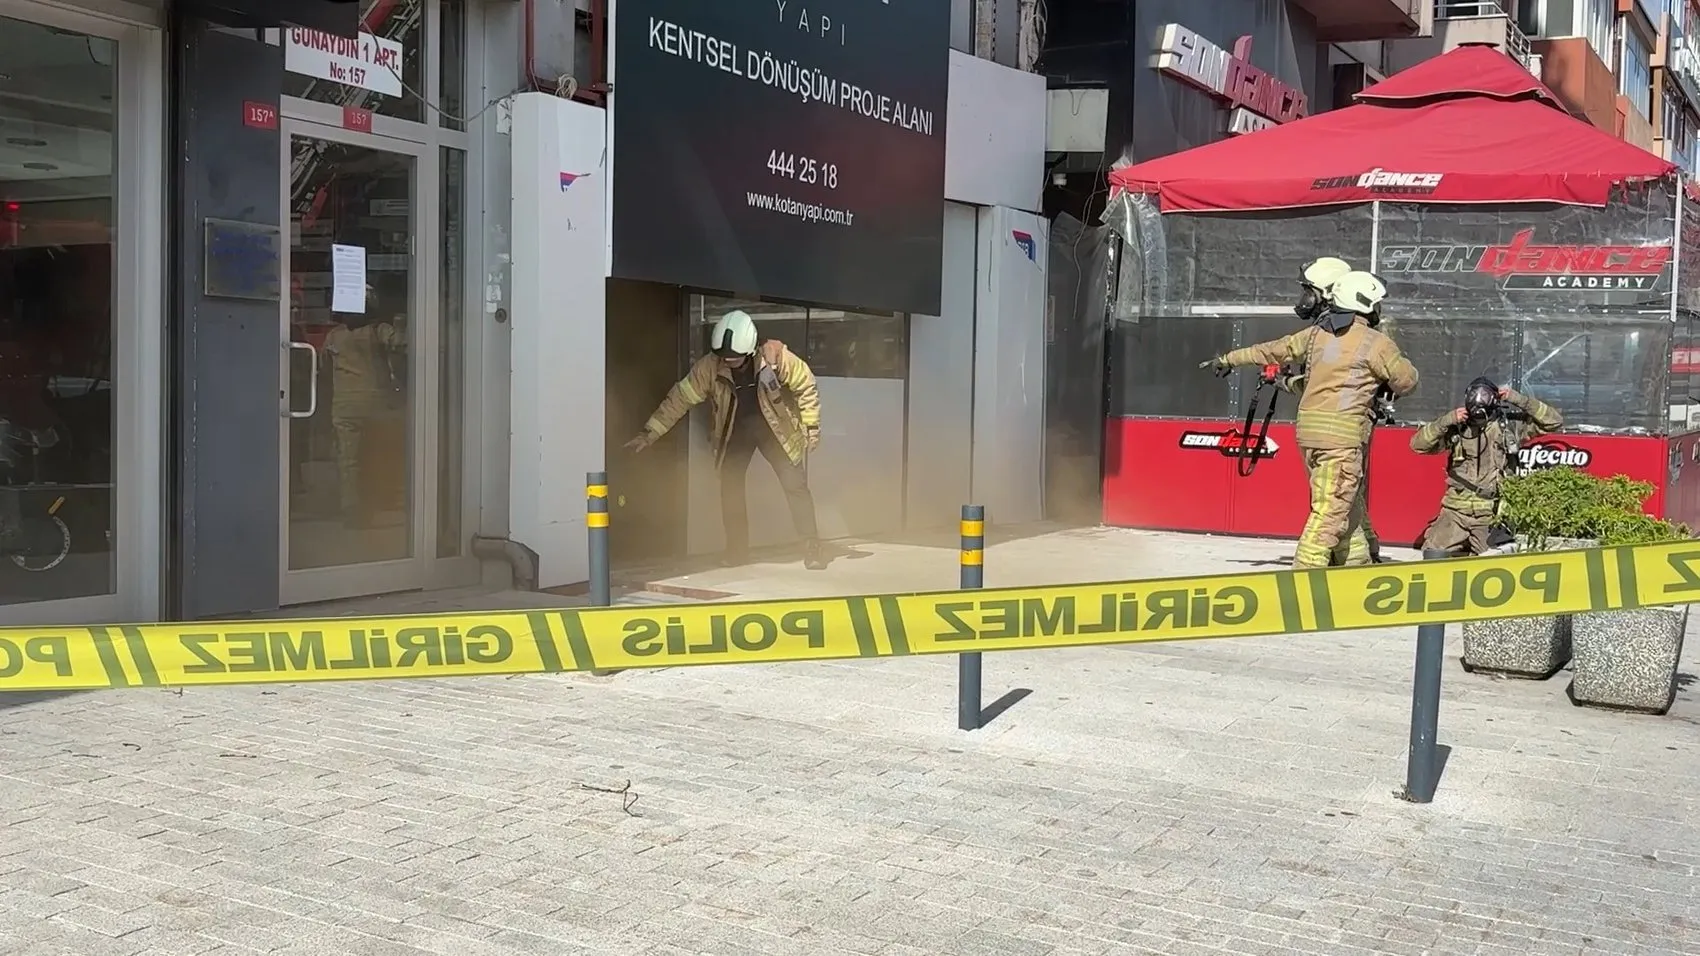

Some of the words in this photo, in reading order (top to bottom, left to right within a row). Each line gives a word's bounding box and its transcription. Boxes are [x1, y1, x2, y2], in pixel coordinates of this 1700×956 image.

[776, 0, 845, 46] YAPI
[363, 43, 369, 62] 1
[374, 47, 399, 70] APT.
[330, 61, 346, 81] No:
[349, 66, 366, 86] 157
[648, 16, 742, 77] KENTSEL
[747, 51, 837, 107] DÖNÜŞÜM
[841, 81, 890, 123] PROJE
[893, 100, 933, 136] ALANI
[351, 112, 367, 126] 157
[767, 149, 795, 179] 444
[799, 156, 817, 184] 25
[821, 162, 838, 189] 18
[747, 190, 854, 227] www.kotanyapi.com.tr
[1543, 276, 1646, 289] ACADEMY
